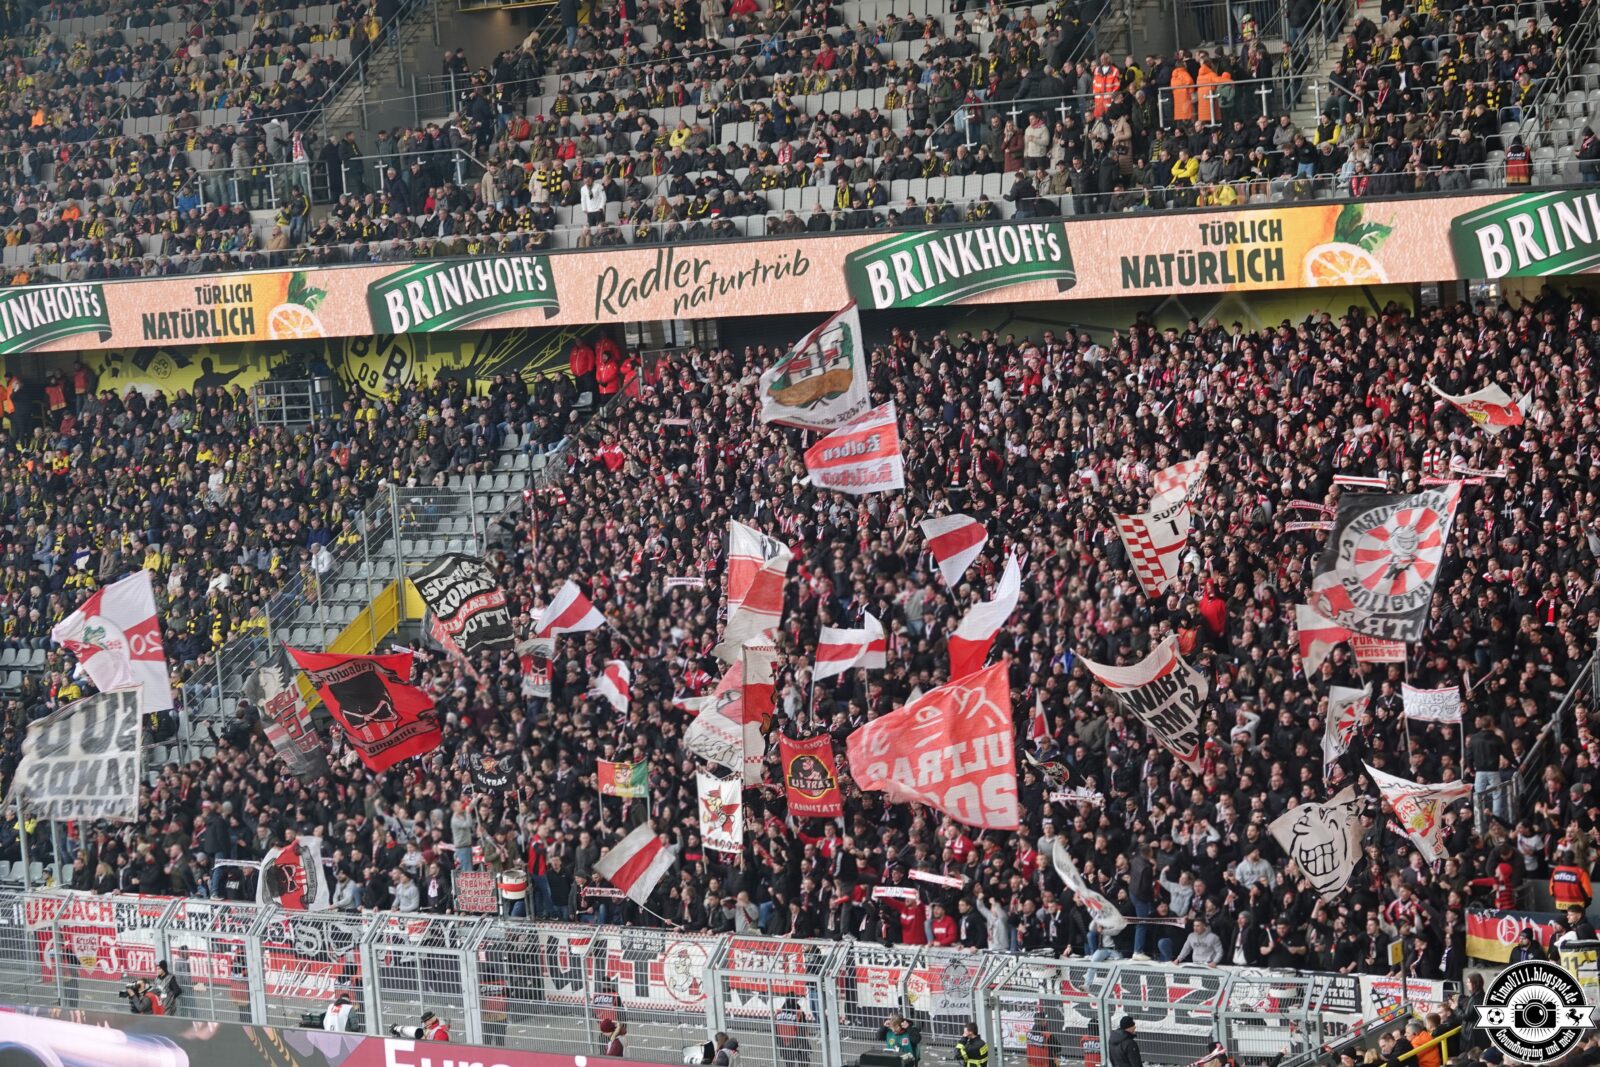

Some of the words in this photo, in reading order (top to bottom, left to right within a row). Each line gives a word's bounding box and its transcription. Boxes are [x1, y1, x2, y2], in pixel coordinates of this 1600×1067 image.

[1199, 219, 1282, 246] TÜRLICH
[673, 249, 809, 315] naturtrüb
[1121, 247, 1284, 290] NATÜRLICH
[194, 283, 253, 305] TÜRLICH
[594, 248, 711, 320] Radler
[142, 306, 255, 341] NATÜRLICH
[358, 362, 379, 389] 09
[477, 773, 508, 787] ULTRAS
[791, 778, 831, 789] ULTRAS
[1553, 871, 1577, 882] atlas
[1336, 976, 1355, 988] UND
